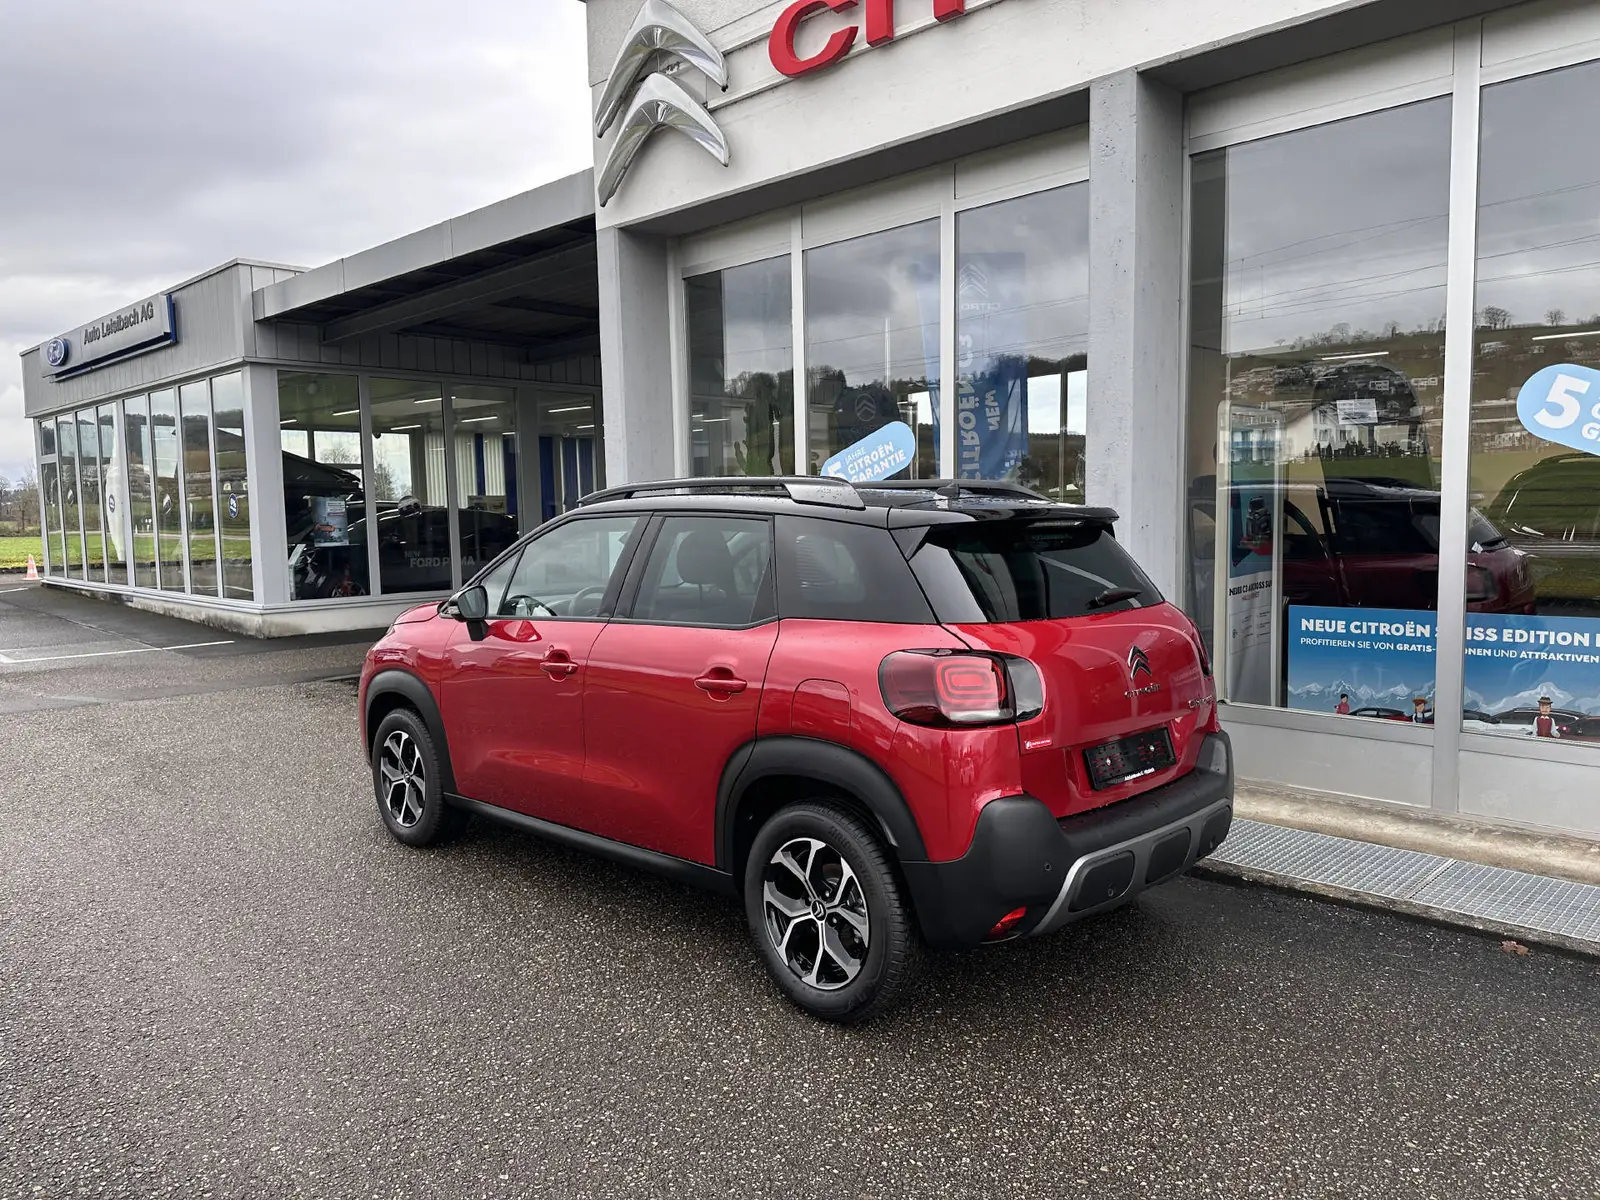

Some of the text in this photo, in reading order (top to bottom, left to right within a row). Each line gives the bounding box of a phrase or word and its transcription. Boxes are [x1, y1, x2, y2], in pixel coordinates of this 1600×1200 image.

[84, 327, 101, 345] Auto
[141, 301, 154, 322] AG
[1533, 373, 1592, 430] 5
[845, 446, 867, 465] JAHRE
[410, 557, 440, 568] FORD
[1301, 618, 1347, 634] NEUE
[1349, 620, 1431, 638] CITROËN
[1502, 628, 1590, 648] EDITION
[1300, 637, 1355, 649] PROFITIEREN
[1357, 640, 1371, 650] SIE
[1372, 641, 1394, 651] VON
[1493, 649, 1518, 659] UND
[1519, 650, 1600, 663] ATTRAKTIVEN
